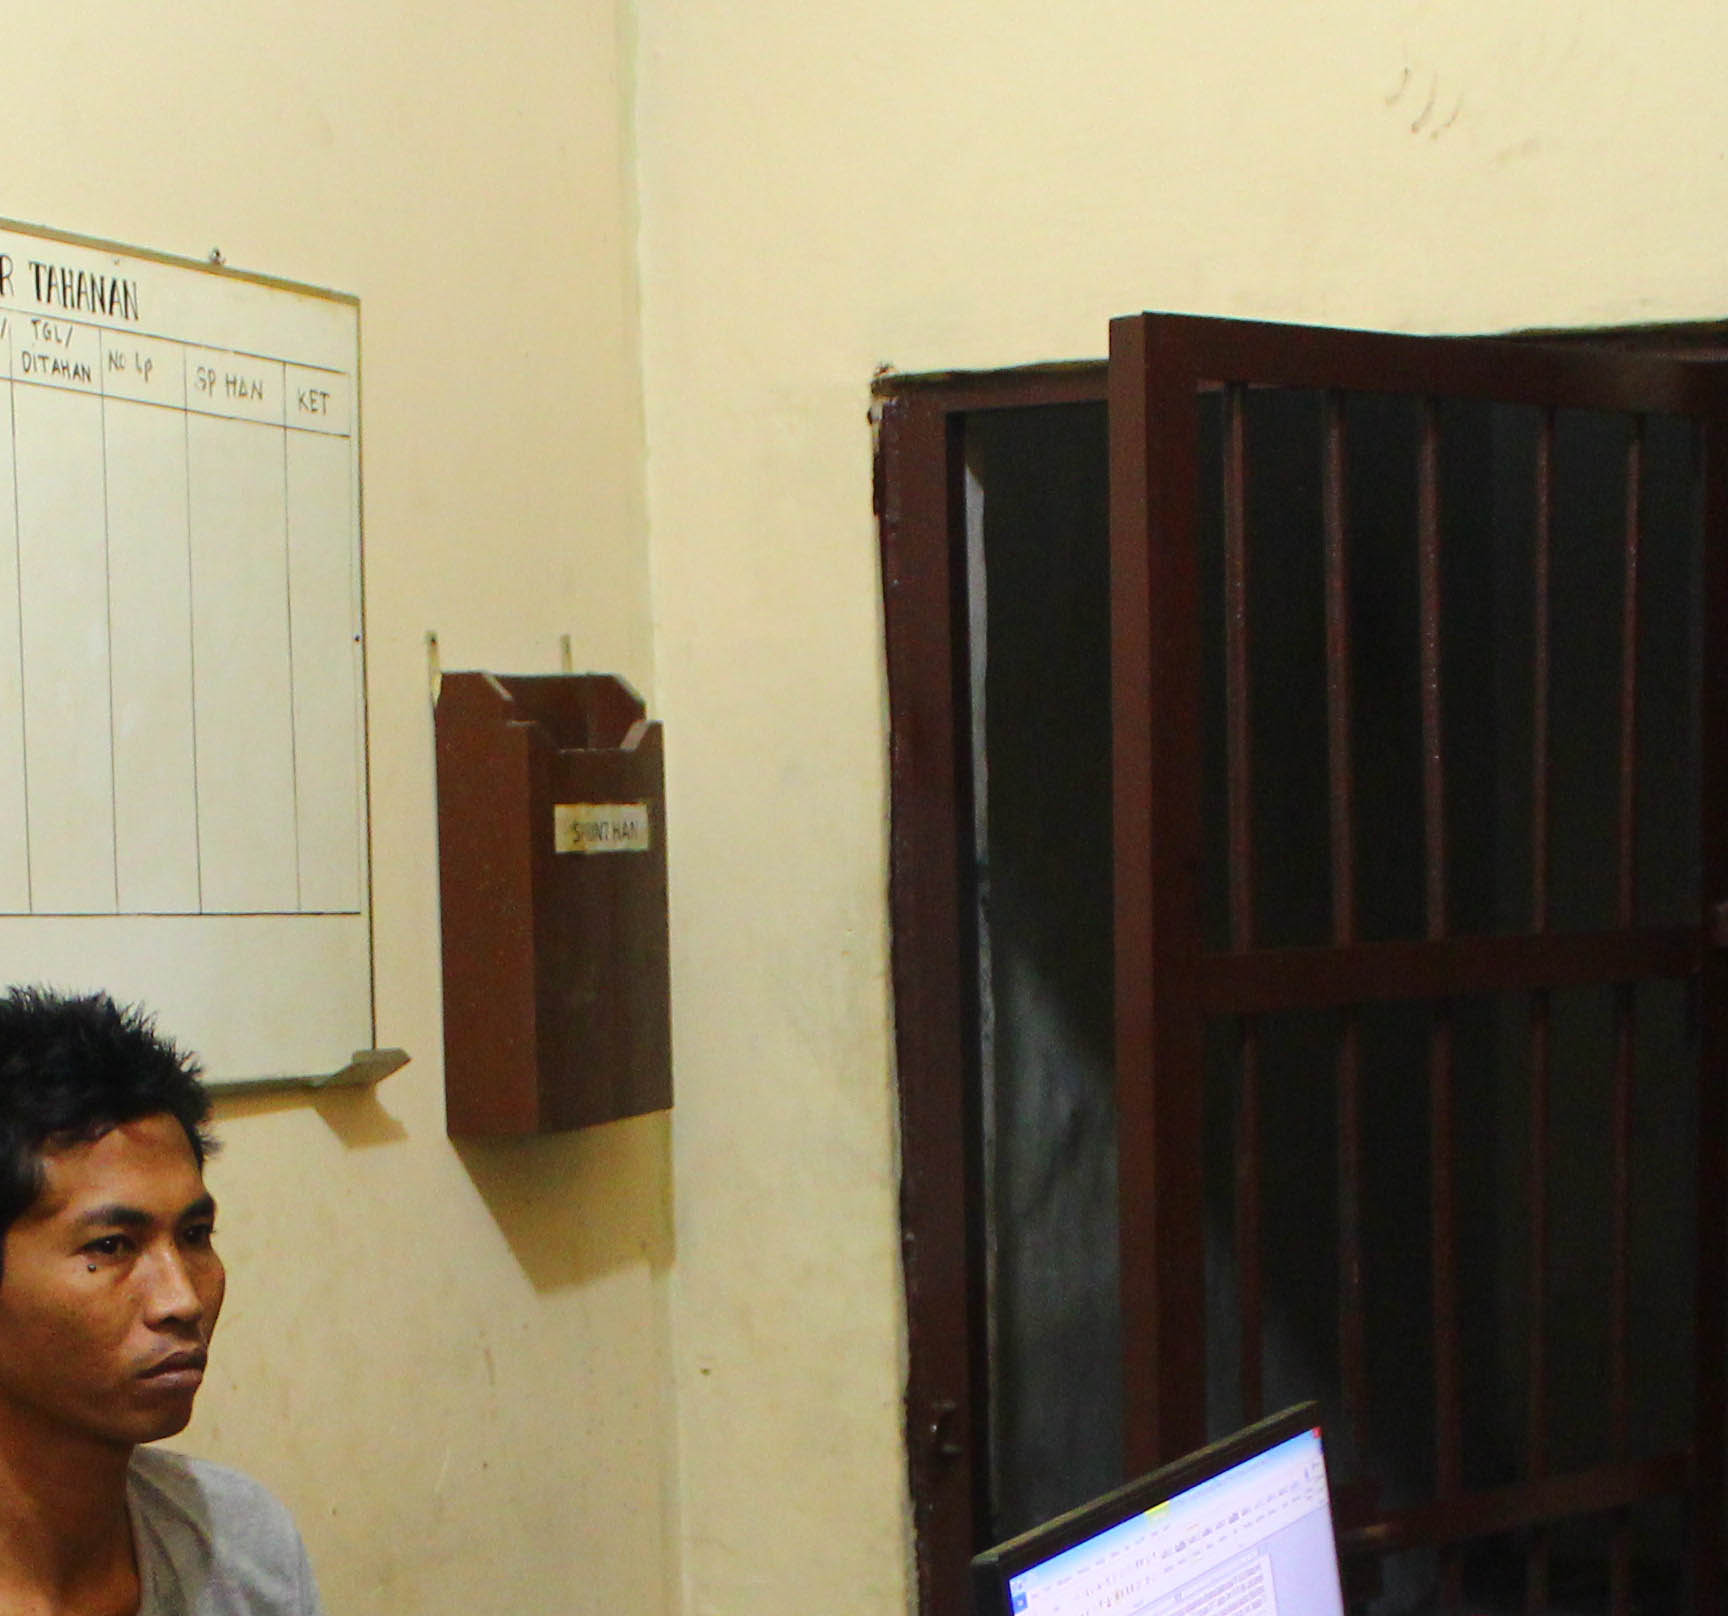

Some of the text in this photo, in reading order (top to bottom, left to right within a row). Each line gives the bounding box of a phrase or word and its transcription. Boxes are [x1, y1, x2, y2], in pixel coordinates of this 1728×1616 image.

[28, 260, 139, 320] TAHANAN
[22, 350, 92, 383] DITAHAN
[297, 387, 330, 416] KET
